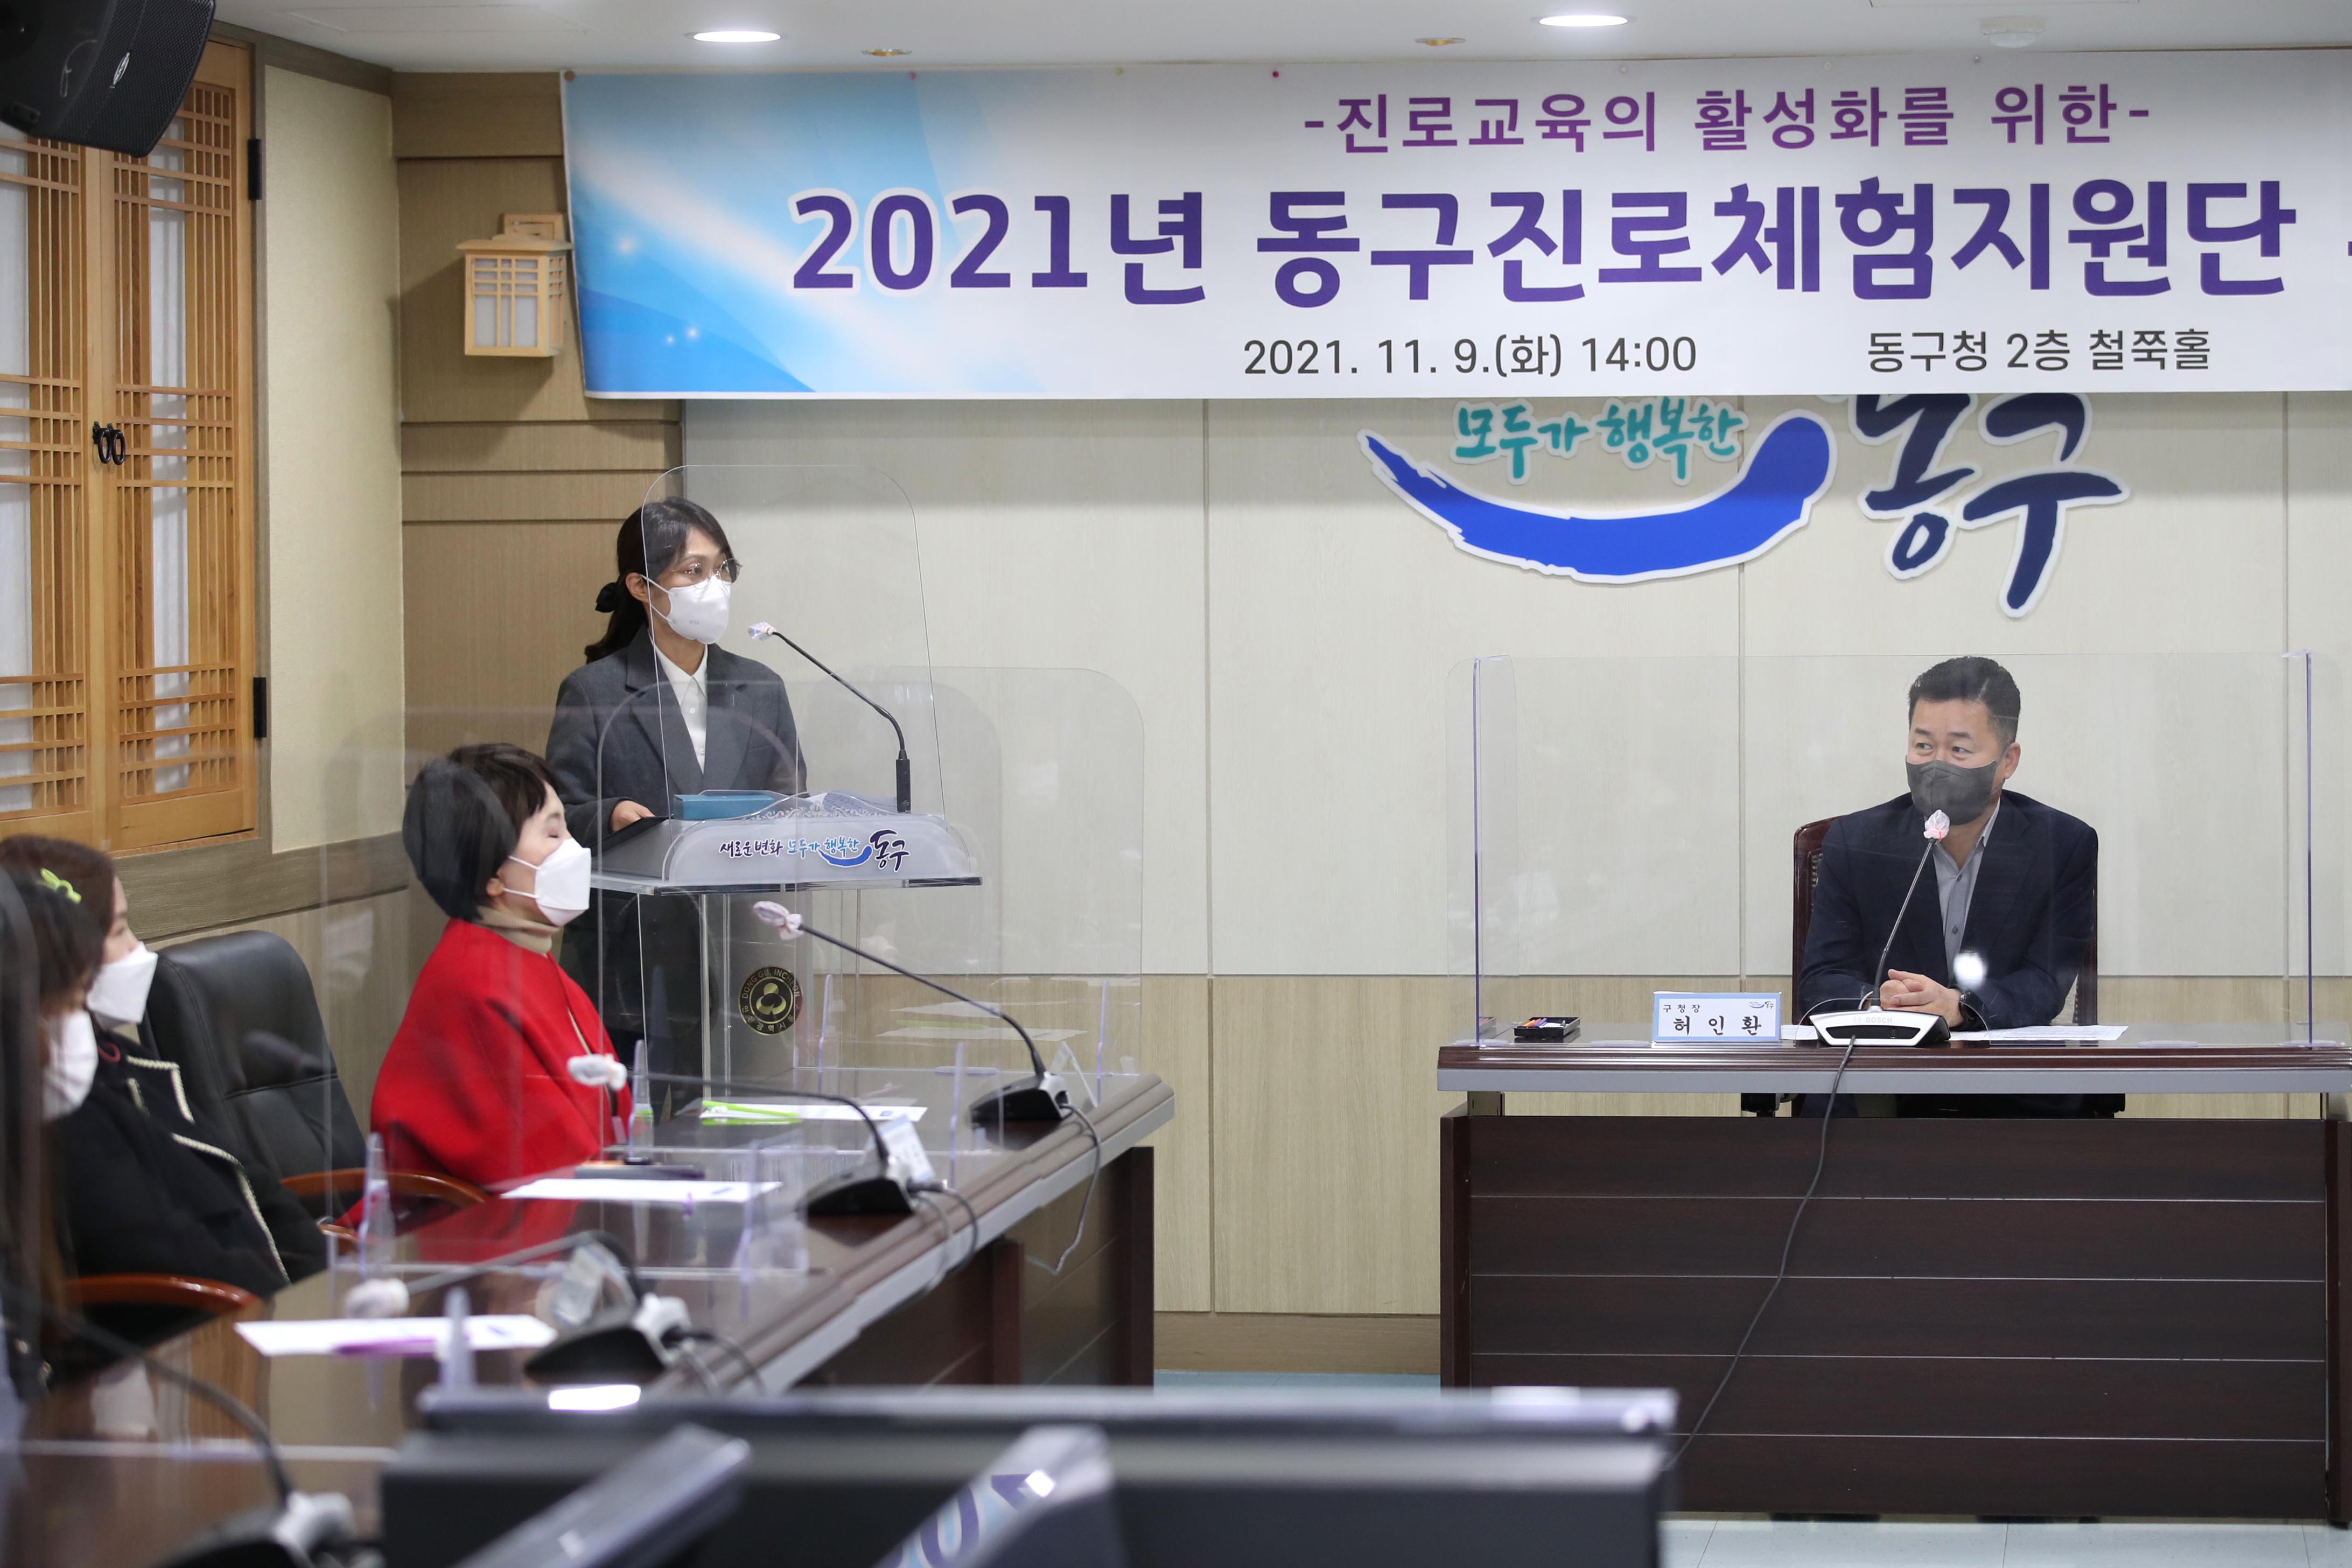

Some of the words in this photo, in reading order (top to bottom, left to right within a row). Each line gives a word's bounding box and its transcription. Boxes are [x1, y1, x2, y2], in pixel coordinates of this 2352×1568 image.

[1304, 91, 1658, 154] -진로교육의
[1695, 86, 1954, 151] 활성화를
[1991, 81, 2150, 145] 위한-
[793, 191, 1206, 305] 2021년
[1256, 176, 2297, 309] 동구진로체험지원단
[1244, 340, 1357, 374] 2021.
[1378, 339, 1436, 374] 11.
[1455, 334, 1561, 377] 9.(화)
[1583, 337, 1696, 372] 14:00
[1868, 330, 1987, 373] 동구청
[2007, 330, 2070, 372] 2층
[2089, 328, 2210, 370] 철쭉홀
[1455, 404, 1589, 479] 모두가
[1597, 396, 1743, 480] 행복한
[720, 840, 753, 857] 새로운
[754, 840, 783, 856] 변화
[788, 839, 821, 858] 모두가
[824, 836, 860, 857] 행복한
[870, 829, 910, 871] 동구
[742, 976, 757, 999] DONG
[774, 969, 801, 997] INCHEON
